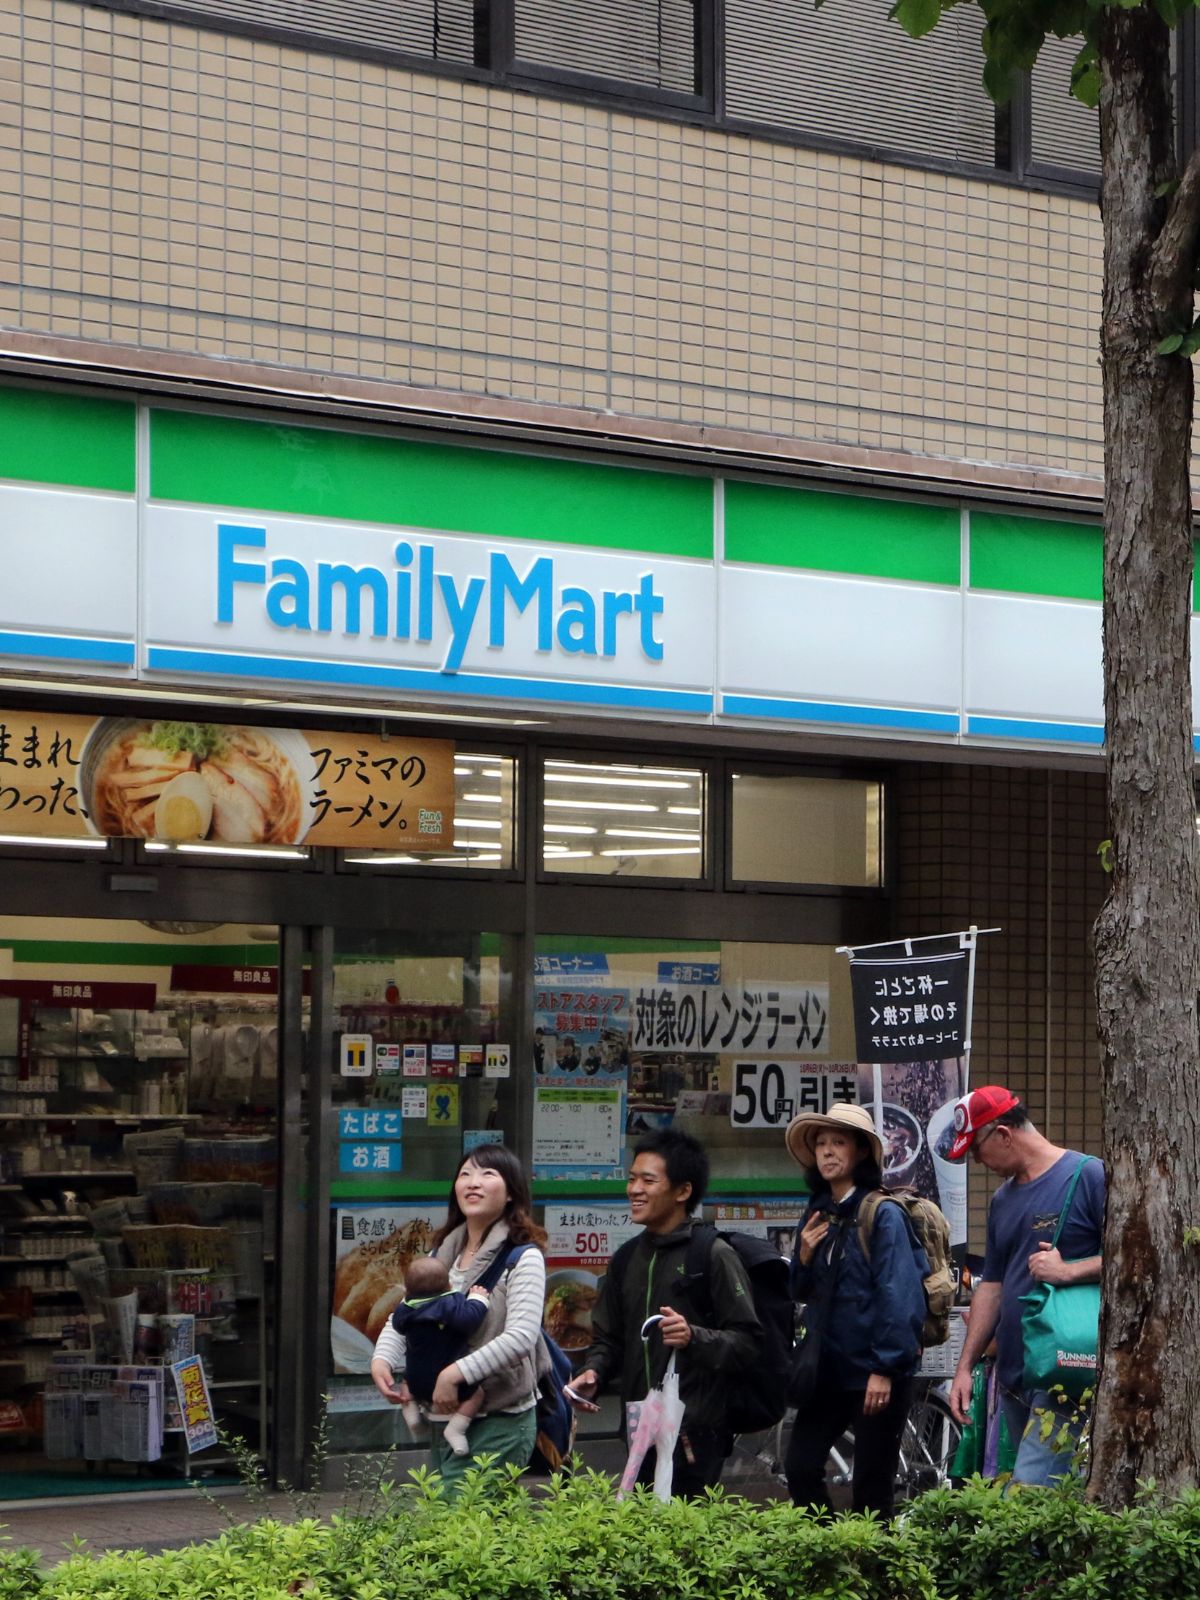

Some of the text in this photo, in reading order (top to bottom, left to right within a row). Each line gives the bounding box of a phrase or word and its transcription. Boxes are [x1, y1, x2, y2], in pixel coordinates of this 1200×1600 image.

[215, 522, 664, 673] FamilyMart
[309, 747, 426, 788] ファミマの
[633, 987, 827, 1050] 対象のレンジラーメン
[343, 1112, 398, 1134] たばこ
[352, 1145, 390, 1168] お酒
